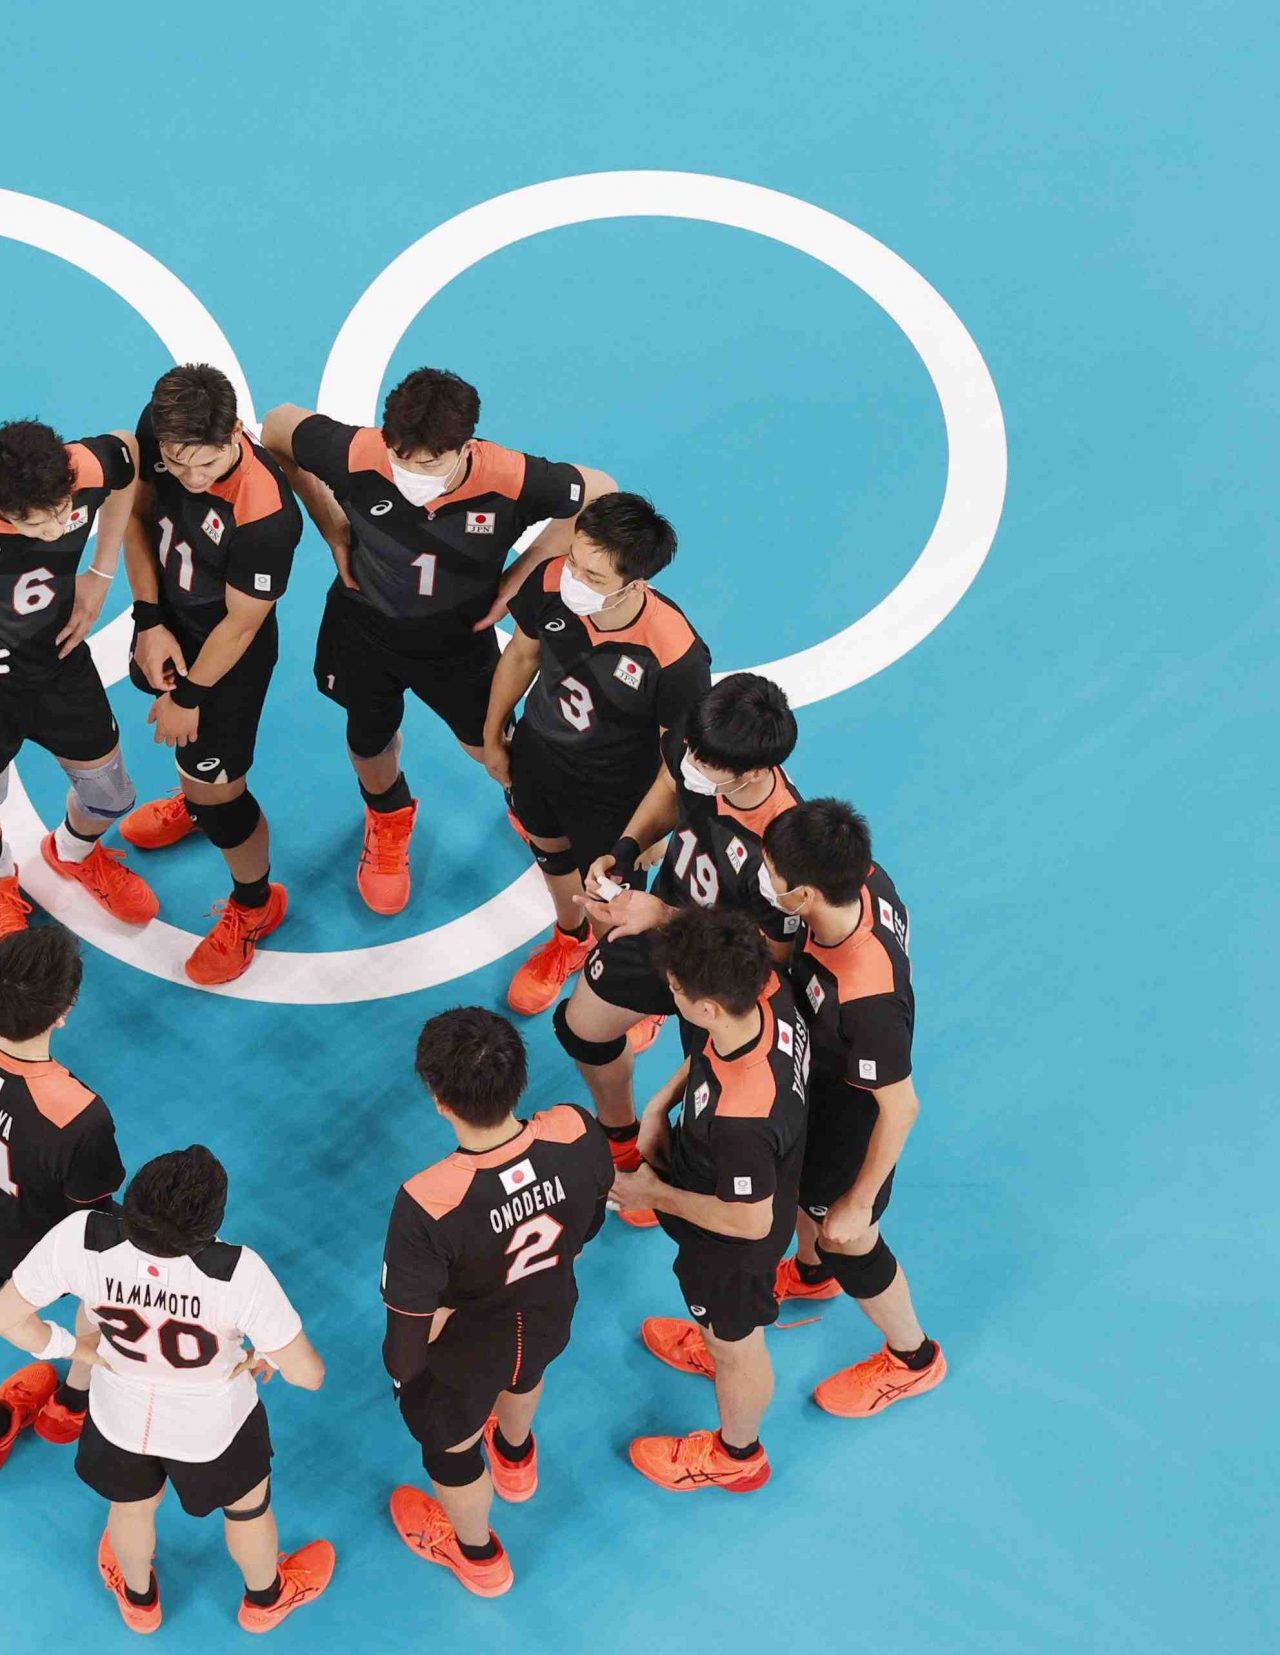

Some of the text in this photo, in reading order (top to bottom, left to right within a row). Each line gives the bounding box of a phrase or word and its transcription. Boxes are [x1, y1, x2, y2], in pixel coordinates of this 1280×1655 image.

[158, 516, 194, 594] 11
[410, 552, 437, 597] 1
[12, 566, 56, 616] 6
[326, 673, 336, 690] 1
[558, 674, 595, 732] 3
[673, 828, 720, 909] 19
[588, 949, 604, 980] 19
[489, 1175, 567, 1234] ONODERA
[503, 1212, 564, 1286] 2
[105, 1276, 202, 1319] YAMAMOTO
[91, 1305, 220, 1369] 20
